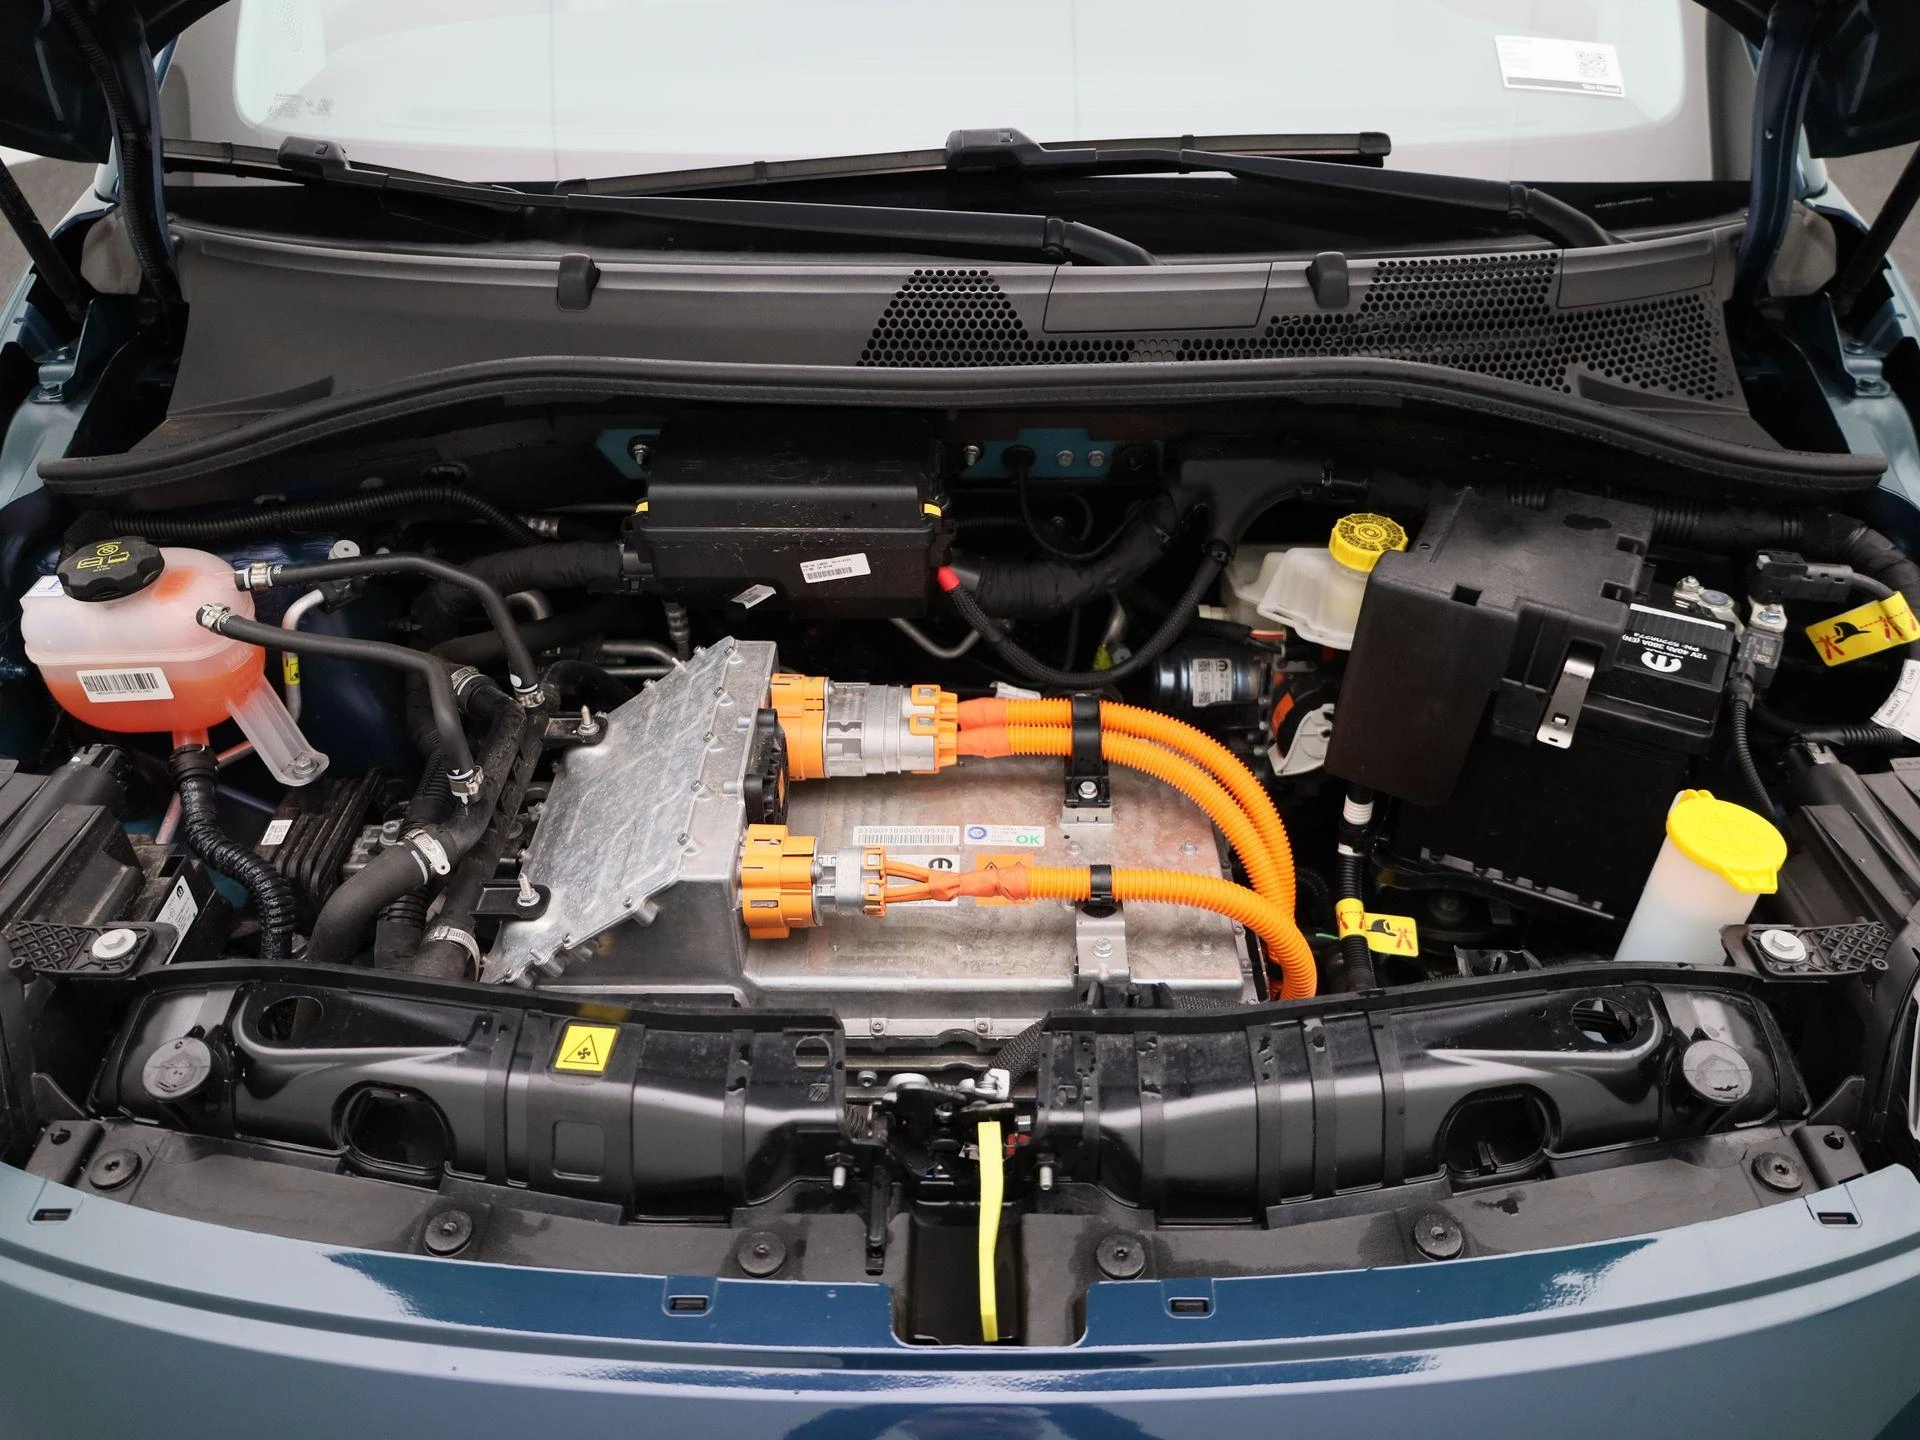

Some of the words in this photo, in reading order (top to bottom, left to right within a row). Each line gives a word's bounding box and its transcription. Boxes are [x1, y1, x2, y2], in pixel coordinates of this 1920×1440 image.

[1621, 634, 1641, 644] (EN)
[1641, 639, 1665, 650] 360A
[1666, 645, 1690, 655] 40Ah
[1690, 652, 1708, 660] 12V
[1015, 834, 1041, 845] OK
